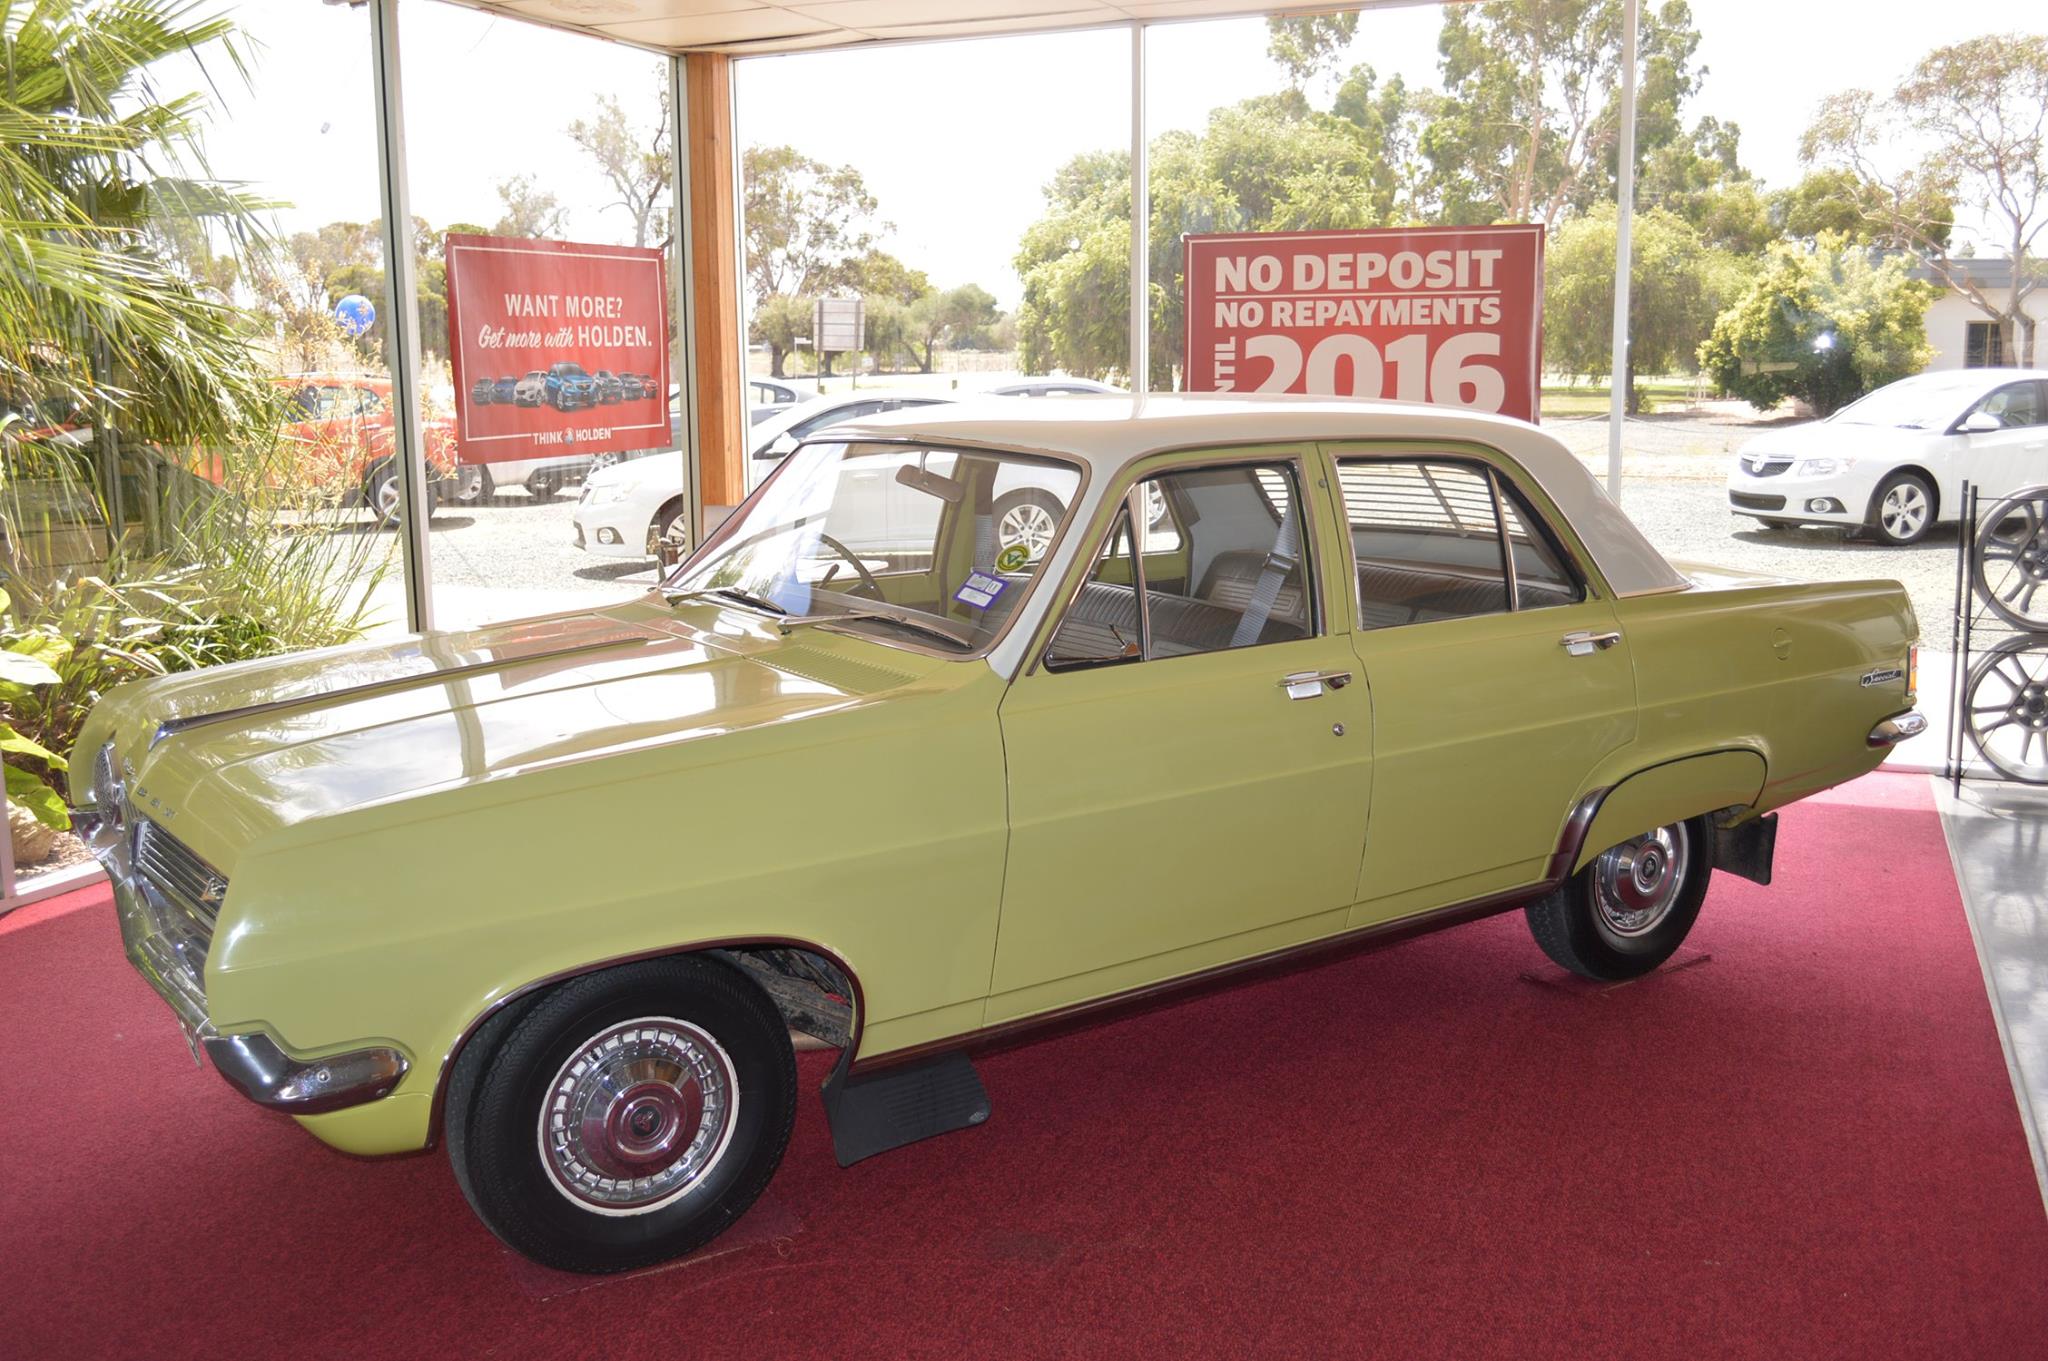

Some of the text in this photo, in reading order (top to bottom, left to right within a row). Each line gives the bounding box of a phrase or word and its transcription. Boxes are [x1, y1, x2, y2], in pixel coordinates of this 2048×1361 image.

[1215, 249, 1503, 292] NO DEPOSIT
[504, 294, 623, 318] WANT MORE?
[1215, 298, 1501, 328] NO REPAYMENTS
[478, 324, 652, 348] Get more with HOLDEN.
[1214, 336, 1236, 392] NTIL
[1245, 332, 1506, 414] 2016
[532, 429, 612, 445] THINK HOLDEN
